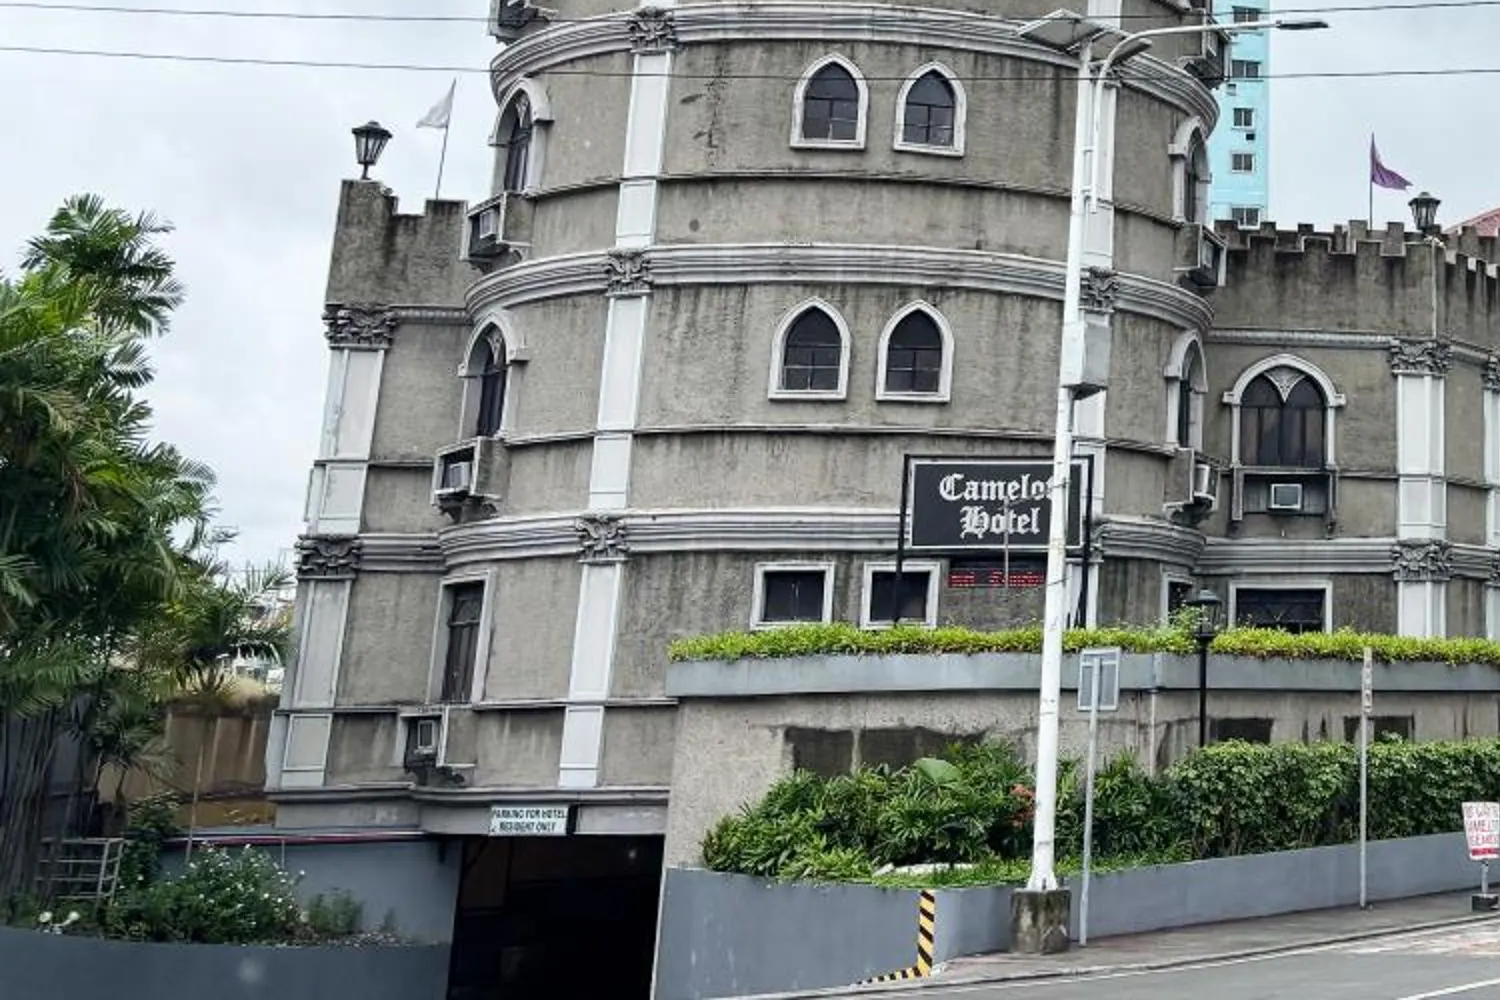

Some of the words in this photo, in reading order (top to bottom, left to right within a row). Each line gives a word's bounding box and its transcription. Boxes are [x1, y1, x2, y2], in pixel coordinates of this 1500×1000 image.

[960, 505, 1041, 539] Hotel
[494, 809, 525, 820] PARKING
[526, 809, 541, 819] FOR
[542, 809, 568, 819] HOTEL
[536, 821, 557, 832] ONLY
